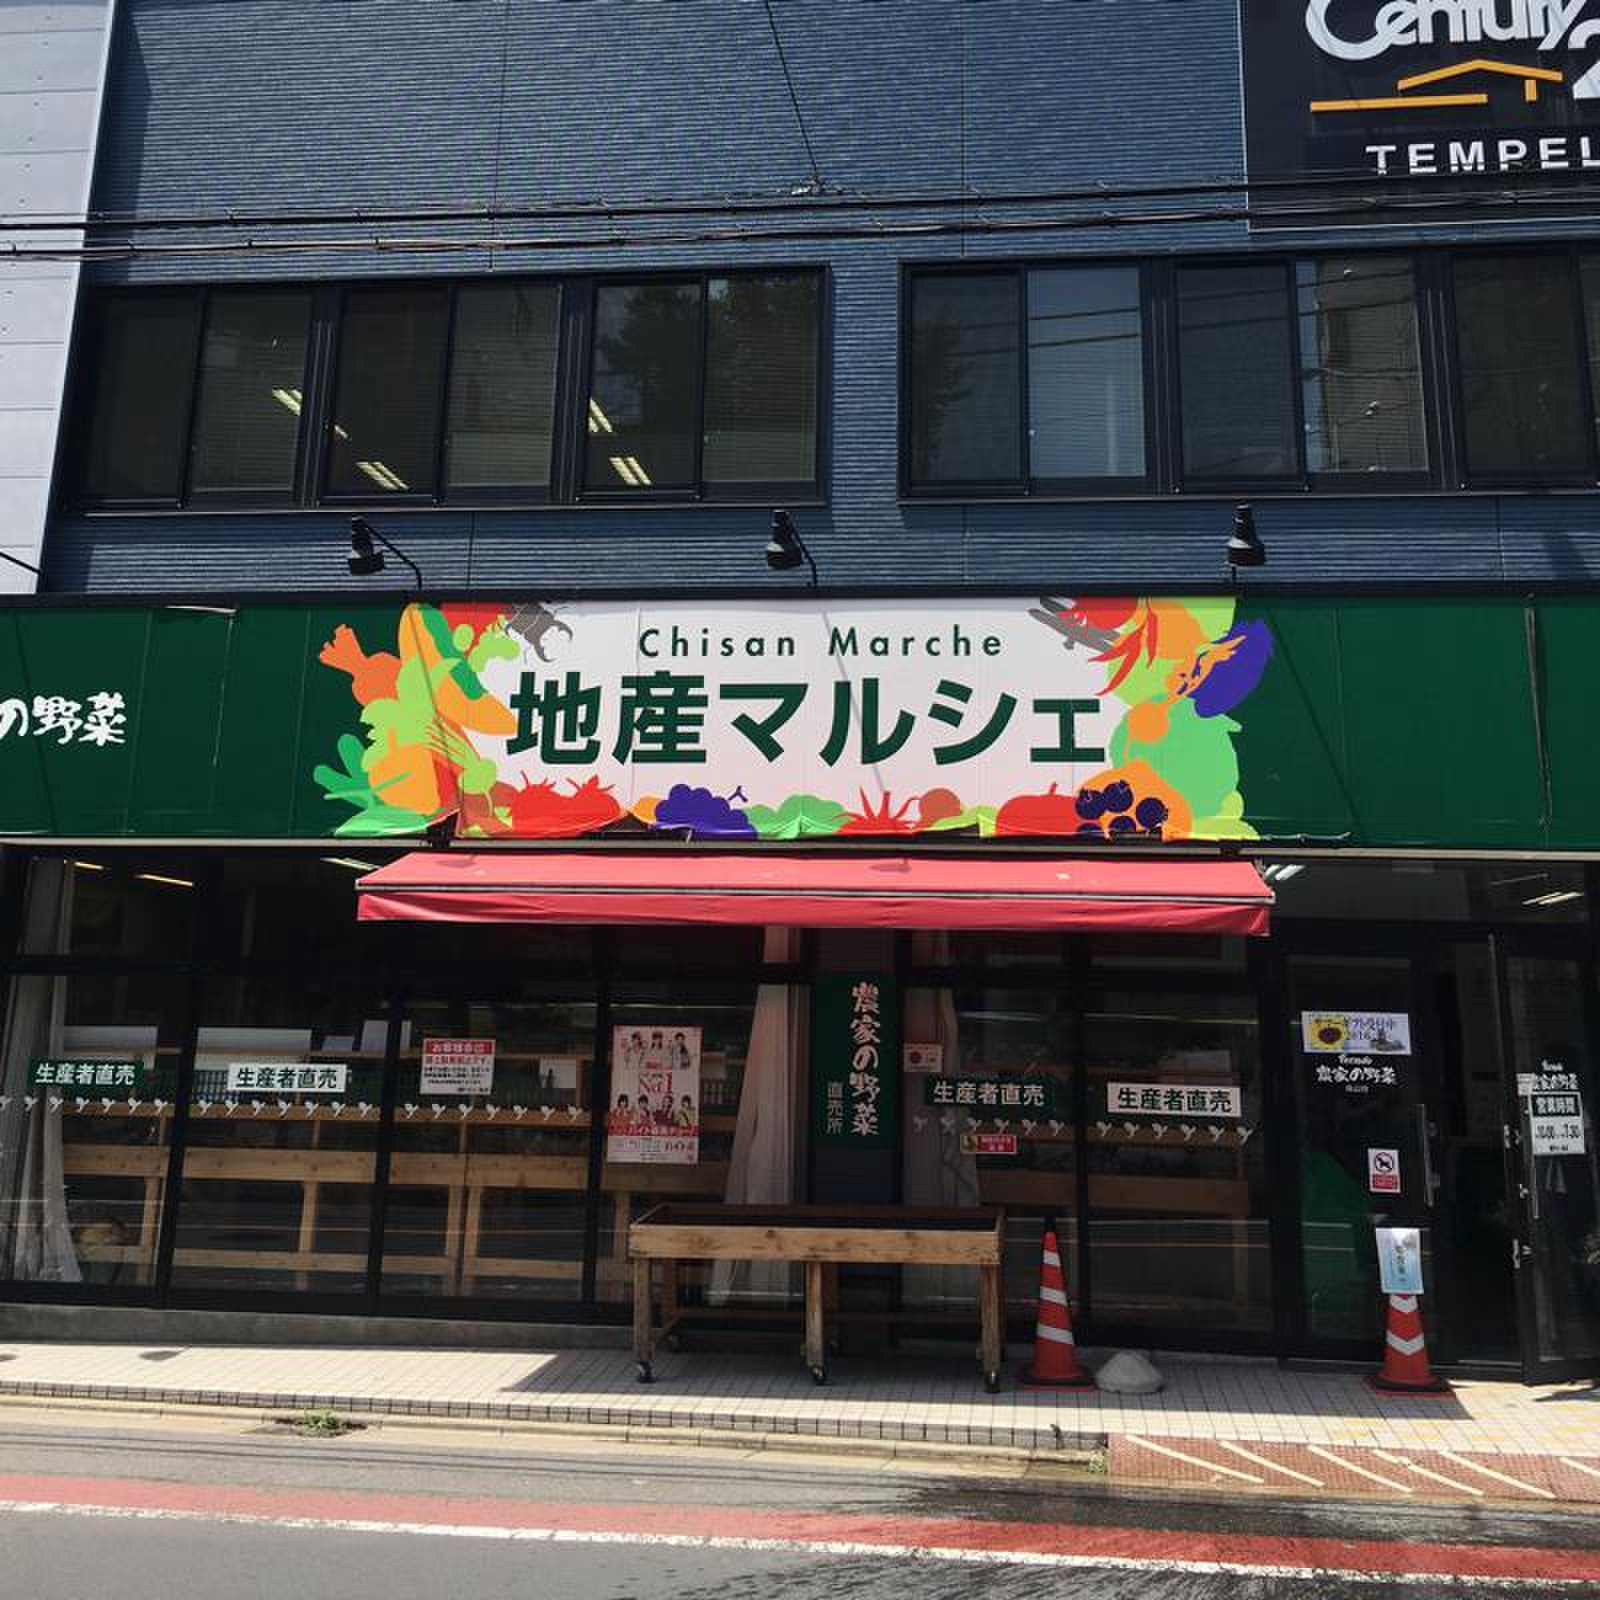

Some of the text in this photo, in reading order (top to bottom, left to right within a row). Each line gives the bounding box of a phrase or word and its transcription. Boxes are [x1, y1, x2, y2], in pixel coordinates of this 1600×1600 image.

[639, 624, 1001, 657] Chisan Marche
[506, 670, 1106, 767] 地産マルシェ
[850, 981, 881, 1136] 農家の野菜
[36, 1063, 134, 1086] 生産者直売
[236, 1067, 338, 1089] 生産者直売
[934, 1081, 1044, 1106] 生産者直売
[1118, 1087, 1232, 1114] 生産者直売
